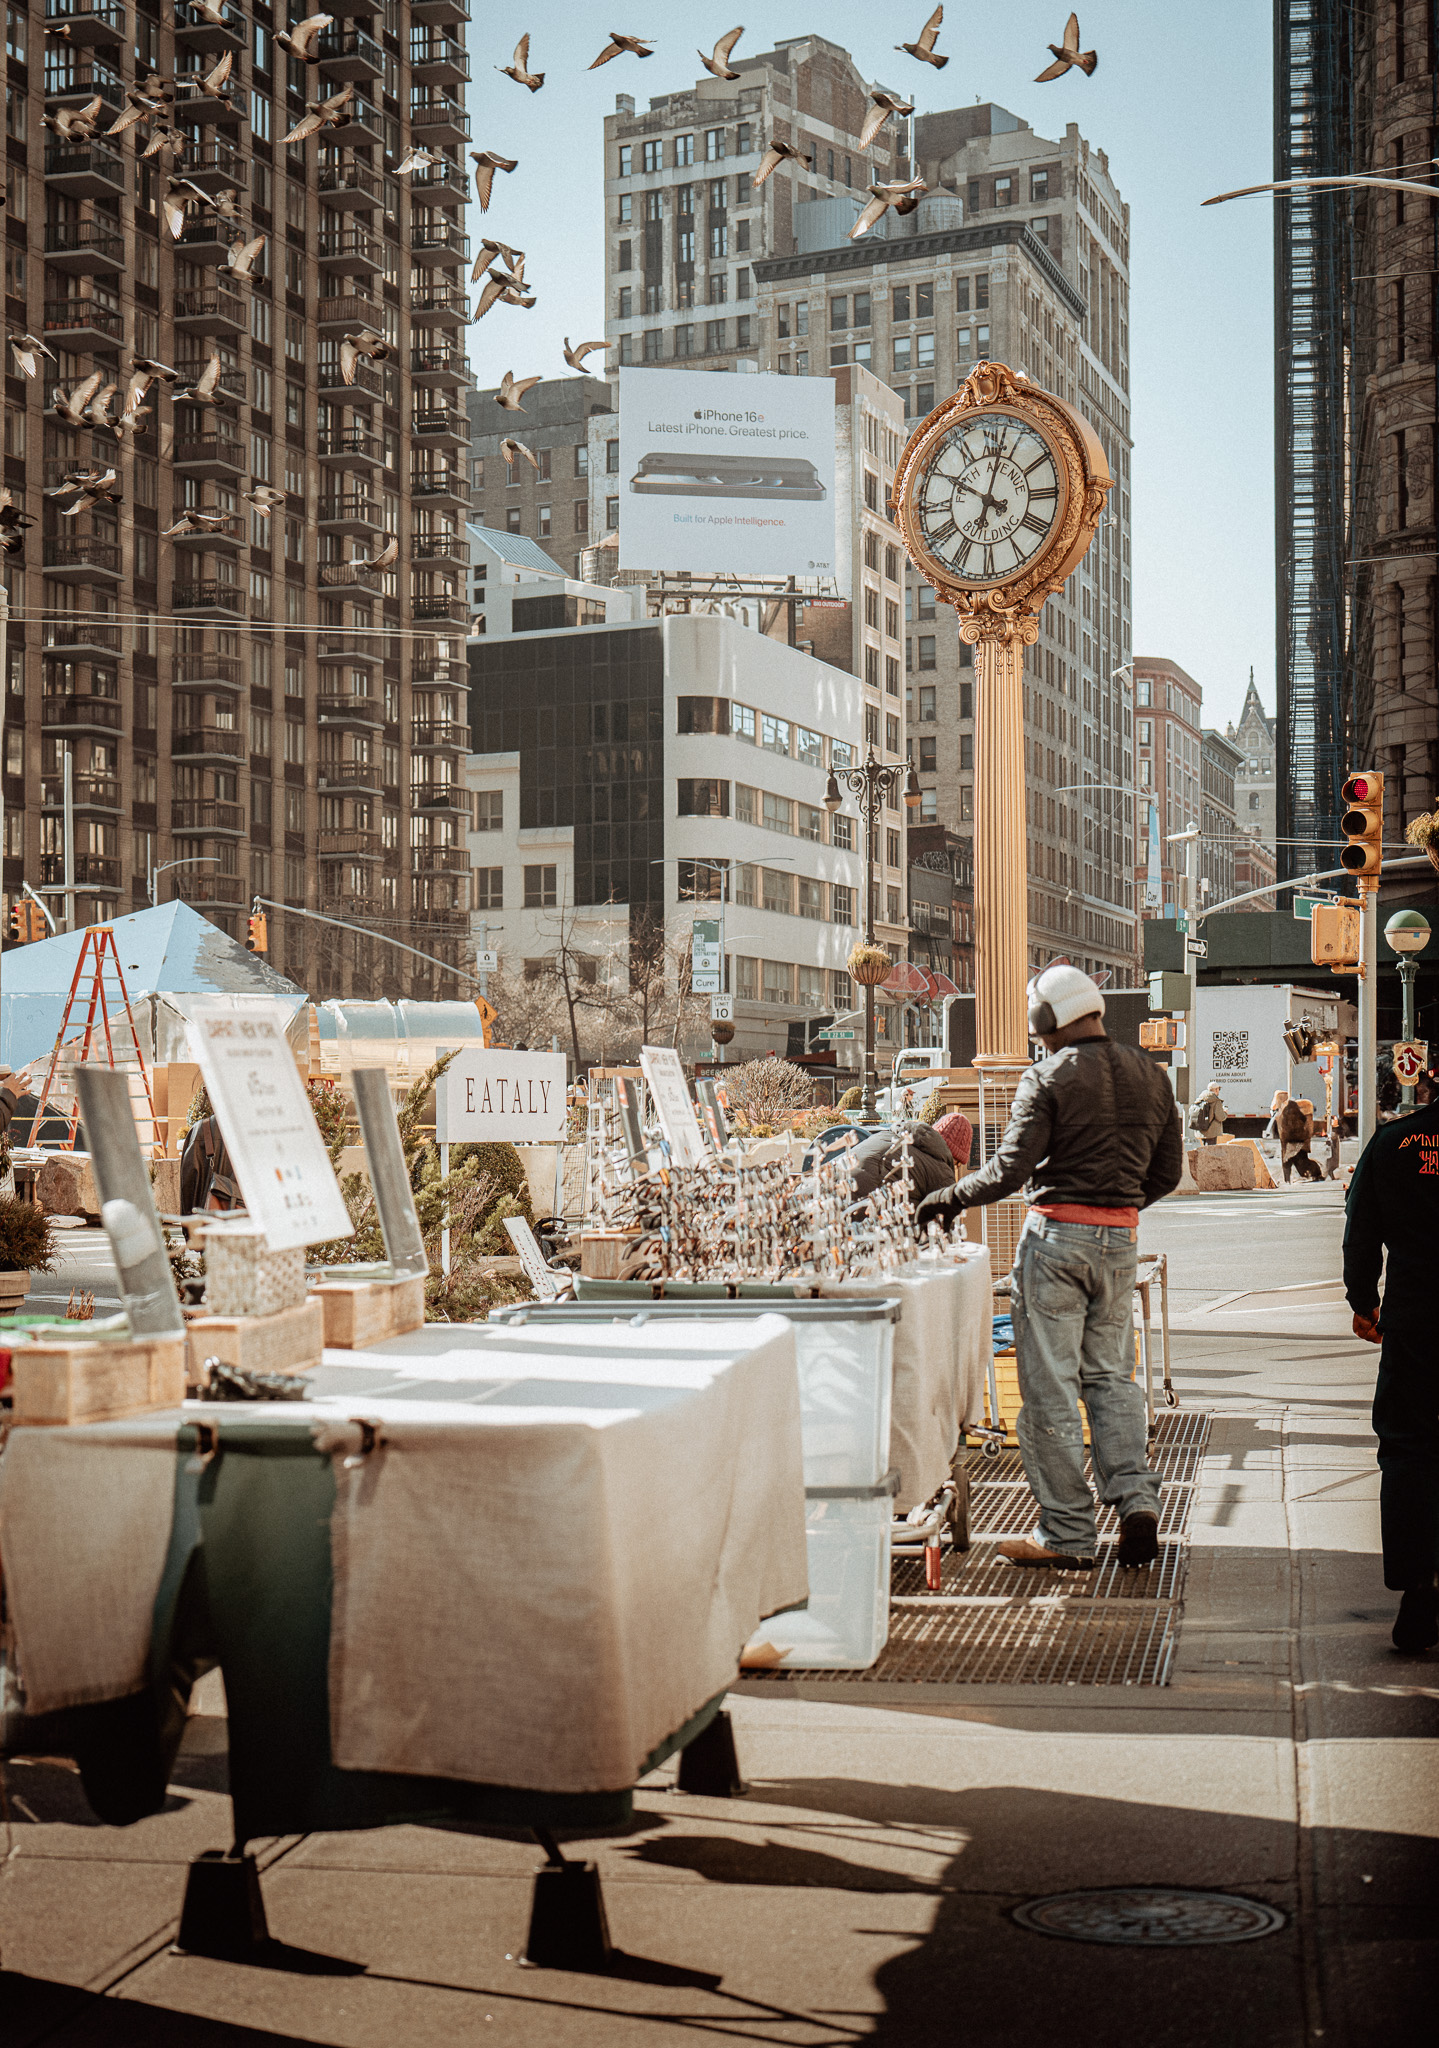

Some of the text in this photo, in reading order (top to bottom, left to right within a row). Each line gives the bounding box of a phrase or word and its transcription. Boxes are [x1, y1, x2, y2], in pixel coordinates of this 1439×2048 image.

[703, 409, 765, 423] iPhone 16e
[648, 421, 809, 440] Latest iPhone. Greatest price.
[673, 513, 786, 527] Built for Apple Intelligence.
[696, 979, 715, 987] Cure
[716, 1008, 728, 1018] 10
[465, 1077, 552, 1114] EATALY
